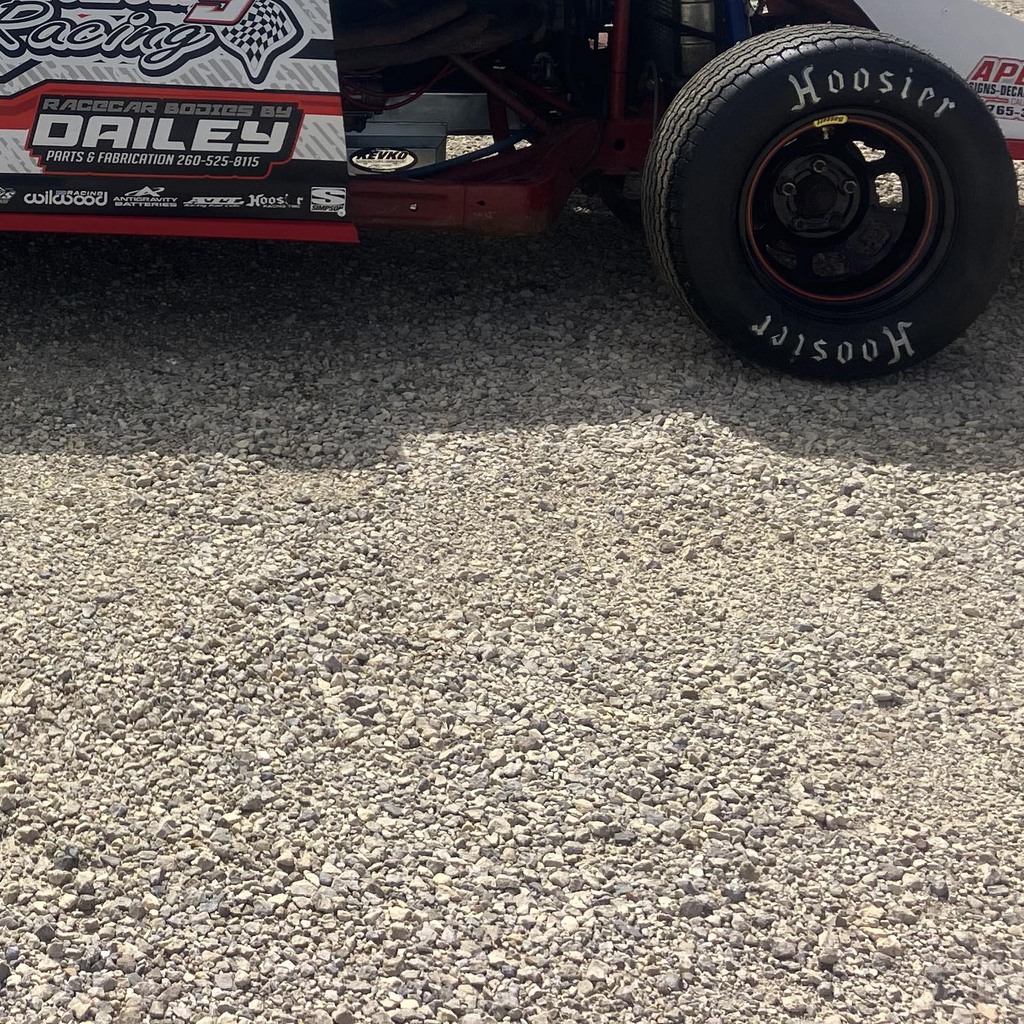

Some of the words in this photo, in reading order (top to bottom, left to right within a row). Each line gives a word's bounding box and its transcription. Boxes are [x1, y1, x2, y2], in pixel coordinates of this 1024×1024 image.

[787, 64, 957, 119] Hoosier
[42, 98, 158, 114] RACECAR
[163, 102, 254, 117] BODIES
[259, 105, 293, 119] BY
[32, 113, 290, 154] DAILEY
[45, 150, 84, 163] PARTS
[86, 152, 96, 163] &
[97, 152, 175, 166] FABRICATION
[176, 155, 261, 168] 260-525-8115
[245, 193, 304, 207] Hoosr
[750, 314, 918, 365] Hoosier
